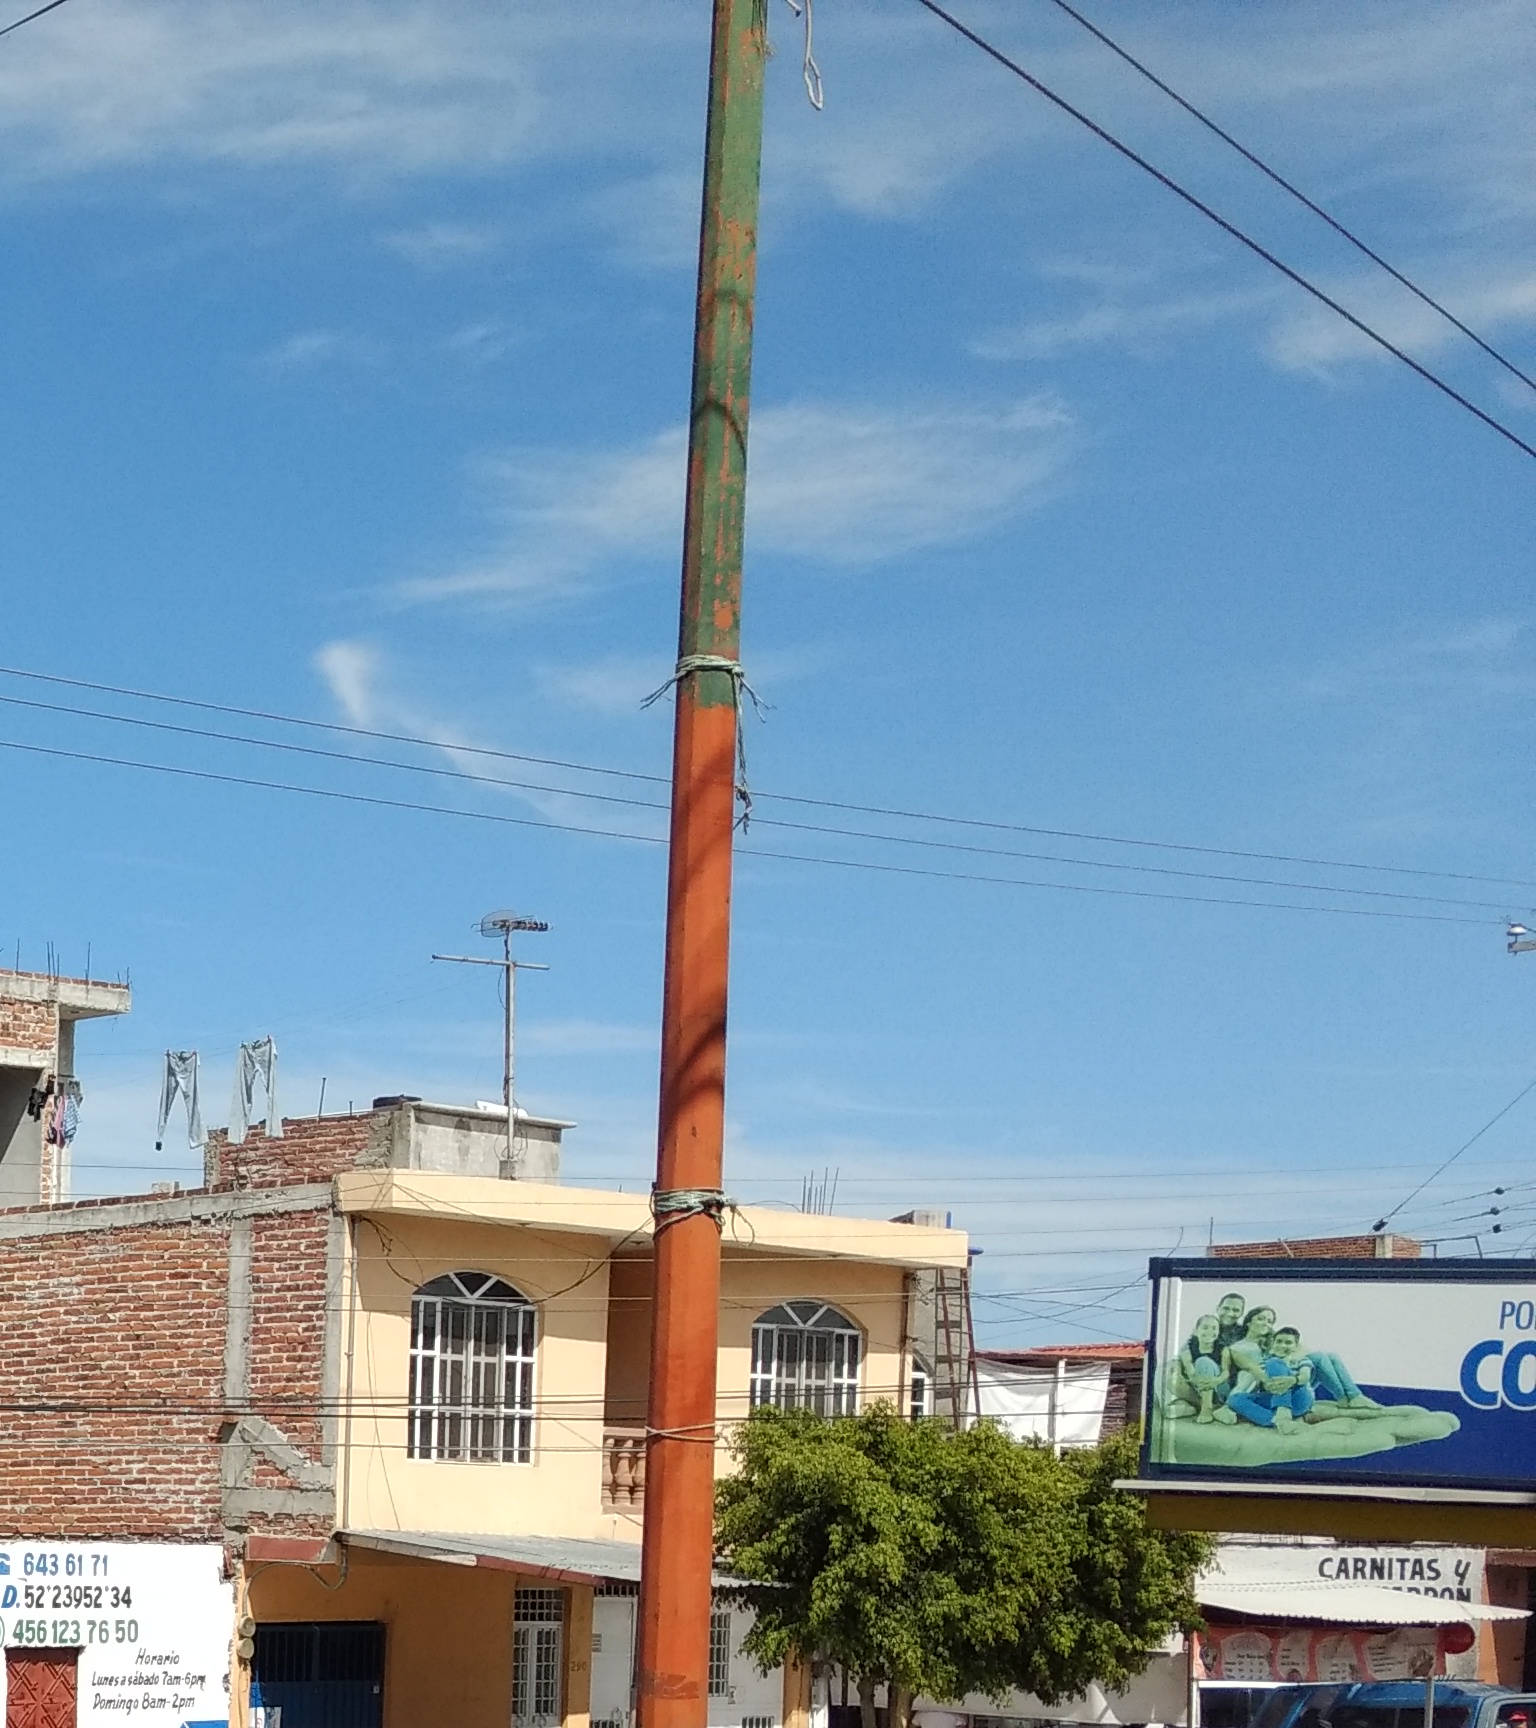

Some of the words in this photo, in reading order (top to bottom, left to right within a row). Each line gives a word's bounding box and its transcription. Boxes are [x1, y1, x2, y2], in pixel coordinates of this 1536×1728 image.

[23, 1552, 59, 1577] 643
[65, 1553, 83, 1577] 61
[91, 1554, 109, 1577] 71
[1318, 1556, 1442, 1581] CARNITAS
[12, 1618, 47, 1644] 456
[52, 1619, 81, 1644] 123
[86, 1620, 110, 1644] 76
[115, 1619, 140, 1644] 50
[134, 1647, 180, 1665] Horario
[91, 1671, 120, 1686] Lunes
[121, 1676, 127, 1686] a
[127, 1670, 160, 1686] sábado
[92, 1693, 140, 1715] Domingo
[141, 1691, 196, 1715] 8am-2pm
